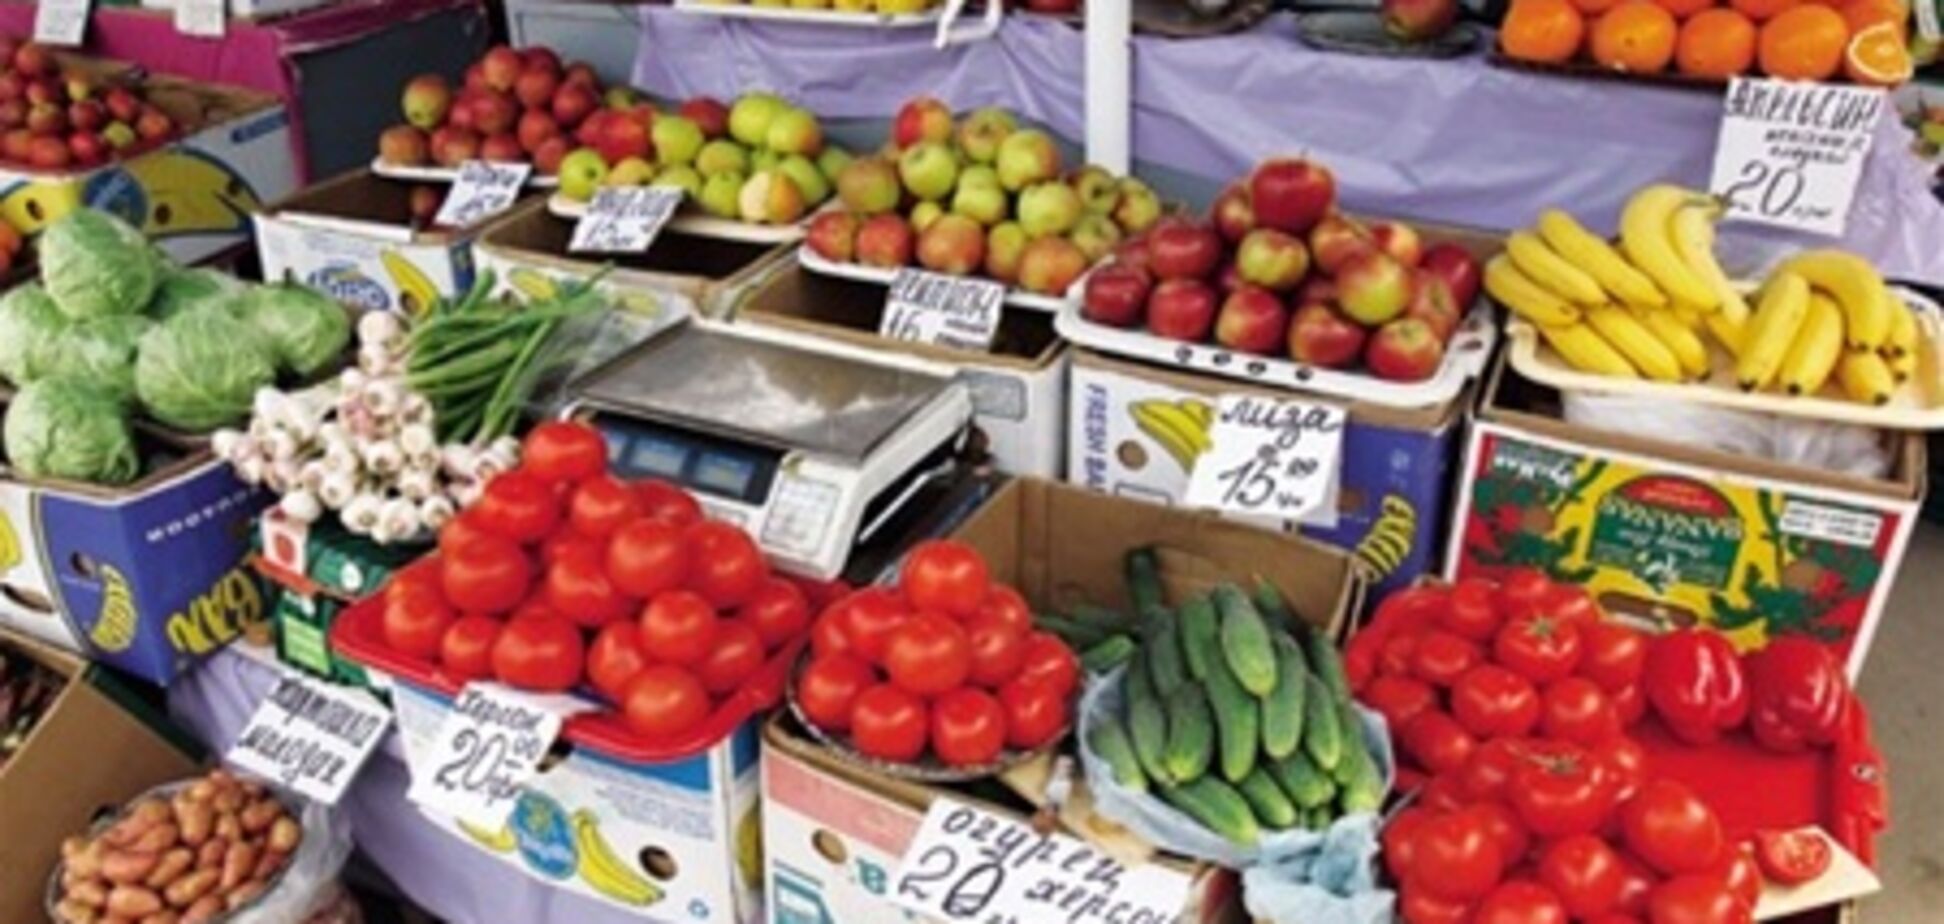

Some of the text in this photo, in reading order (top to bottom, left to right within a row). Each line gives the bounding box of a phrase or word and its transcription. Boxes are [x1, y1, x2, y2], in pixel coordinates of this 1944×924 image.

[1727, 159, 1804, 217] 20
[1218, 452, 1277, 507] 15
[1602, 495, 1742, 541] BANANAS
